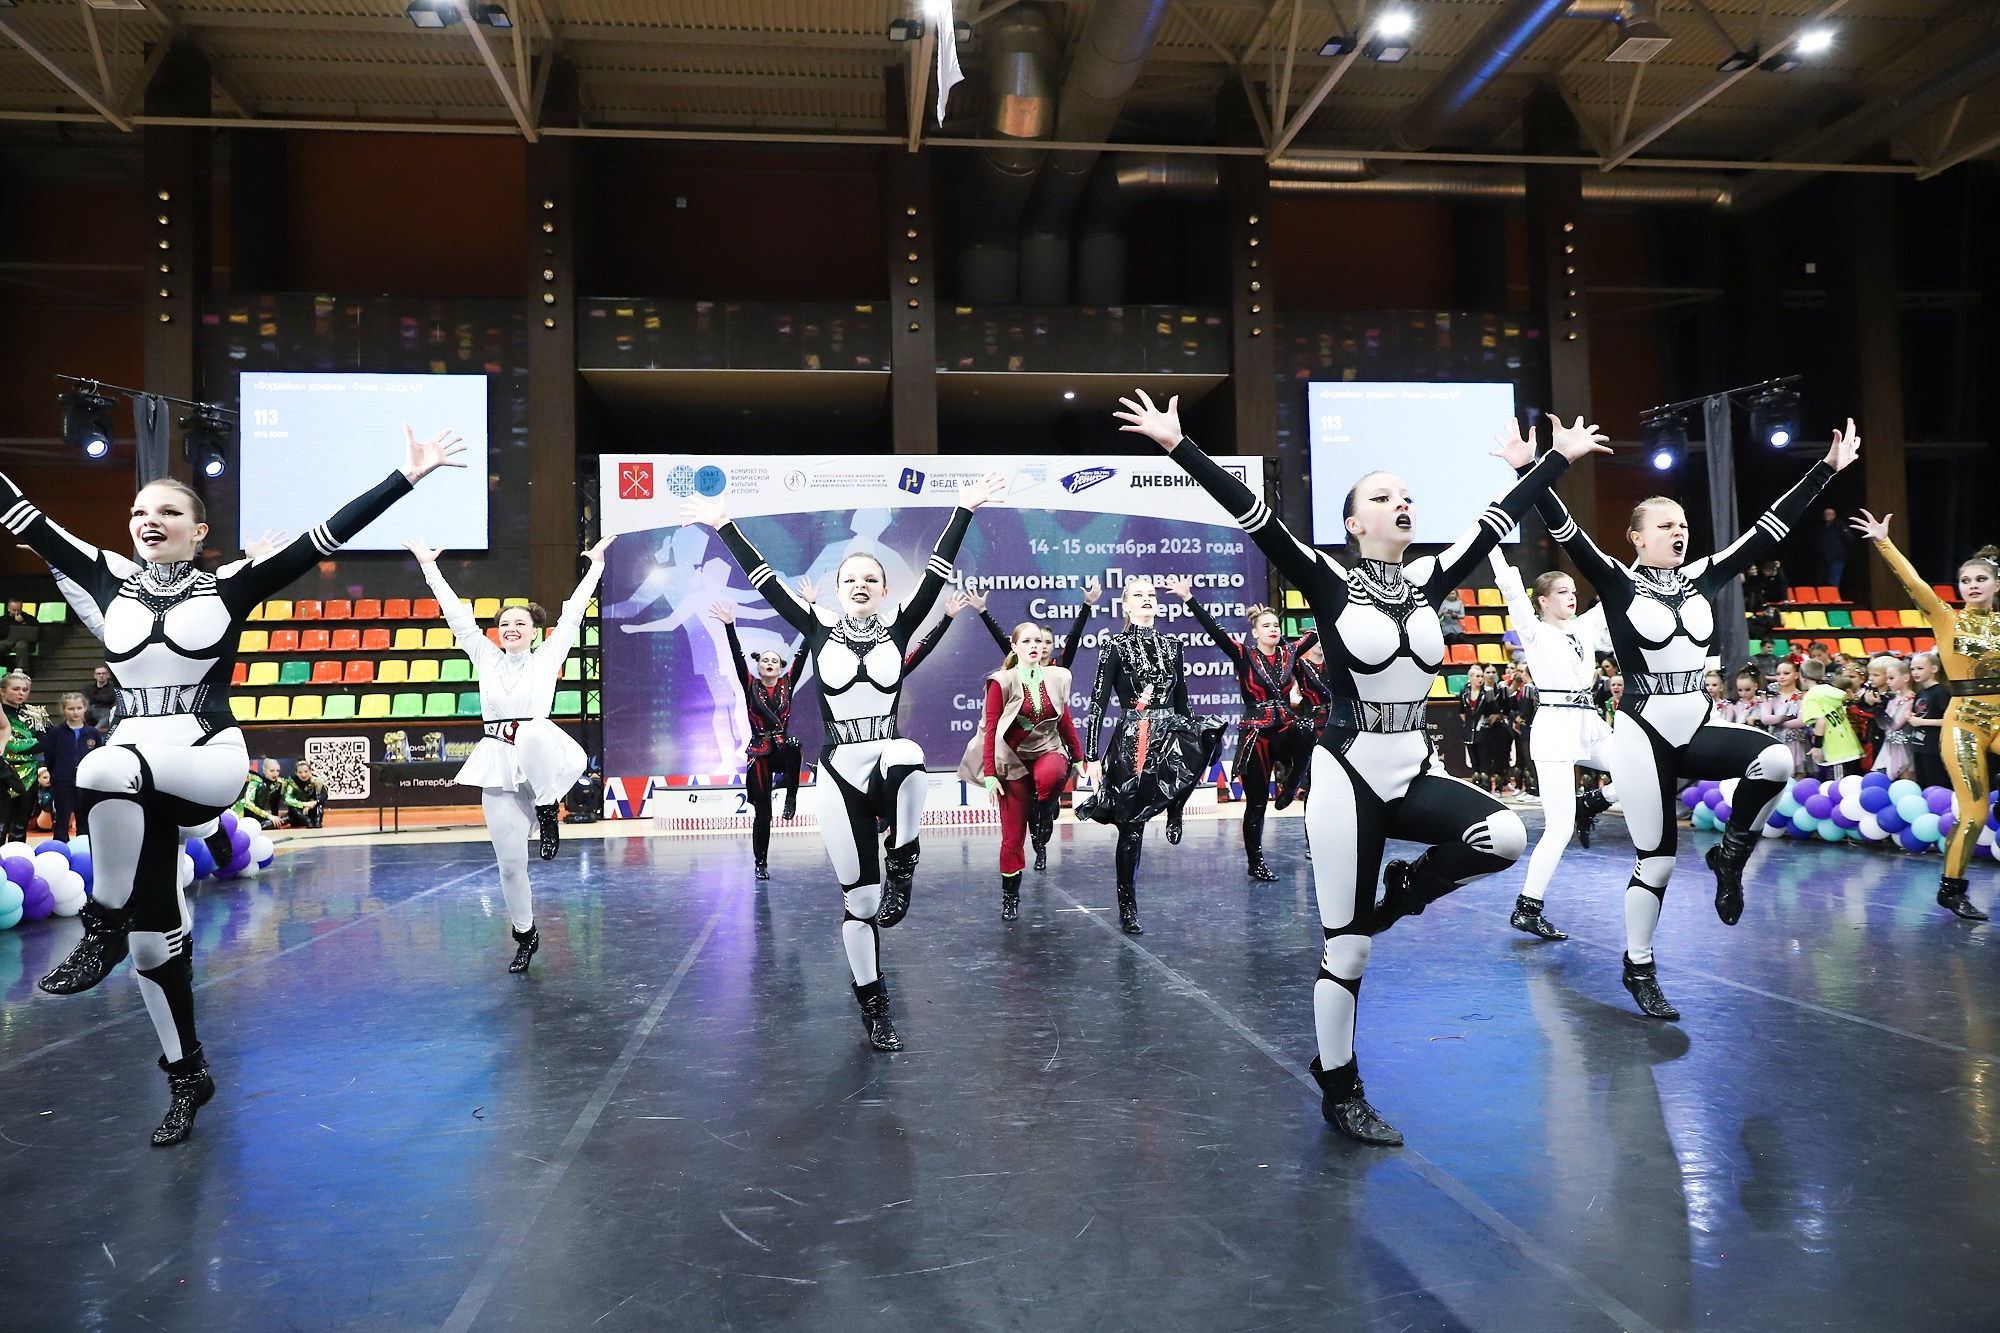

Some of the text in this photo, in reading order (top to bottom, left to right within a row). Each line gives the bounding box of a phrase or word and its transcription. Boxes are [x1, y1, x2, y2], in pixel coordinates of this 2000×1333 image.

[253, 409, 279, 425] 113
[1320, 415, 1343, 430] 113
[1029, 539, 1050, 555] 14
[1062, 539, 1081, 555] 15
[1085, 538, 1157, 557] октября
[1160, 538, 1202, 554] 2023
[1205, 541, 1244, 555] года
[948, 569, 1079, 590] Чемпионат
[951, 719, 972, 732] по
[735, 793, 748, 814] 2
